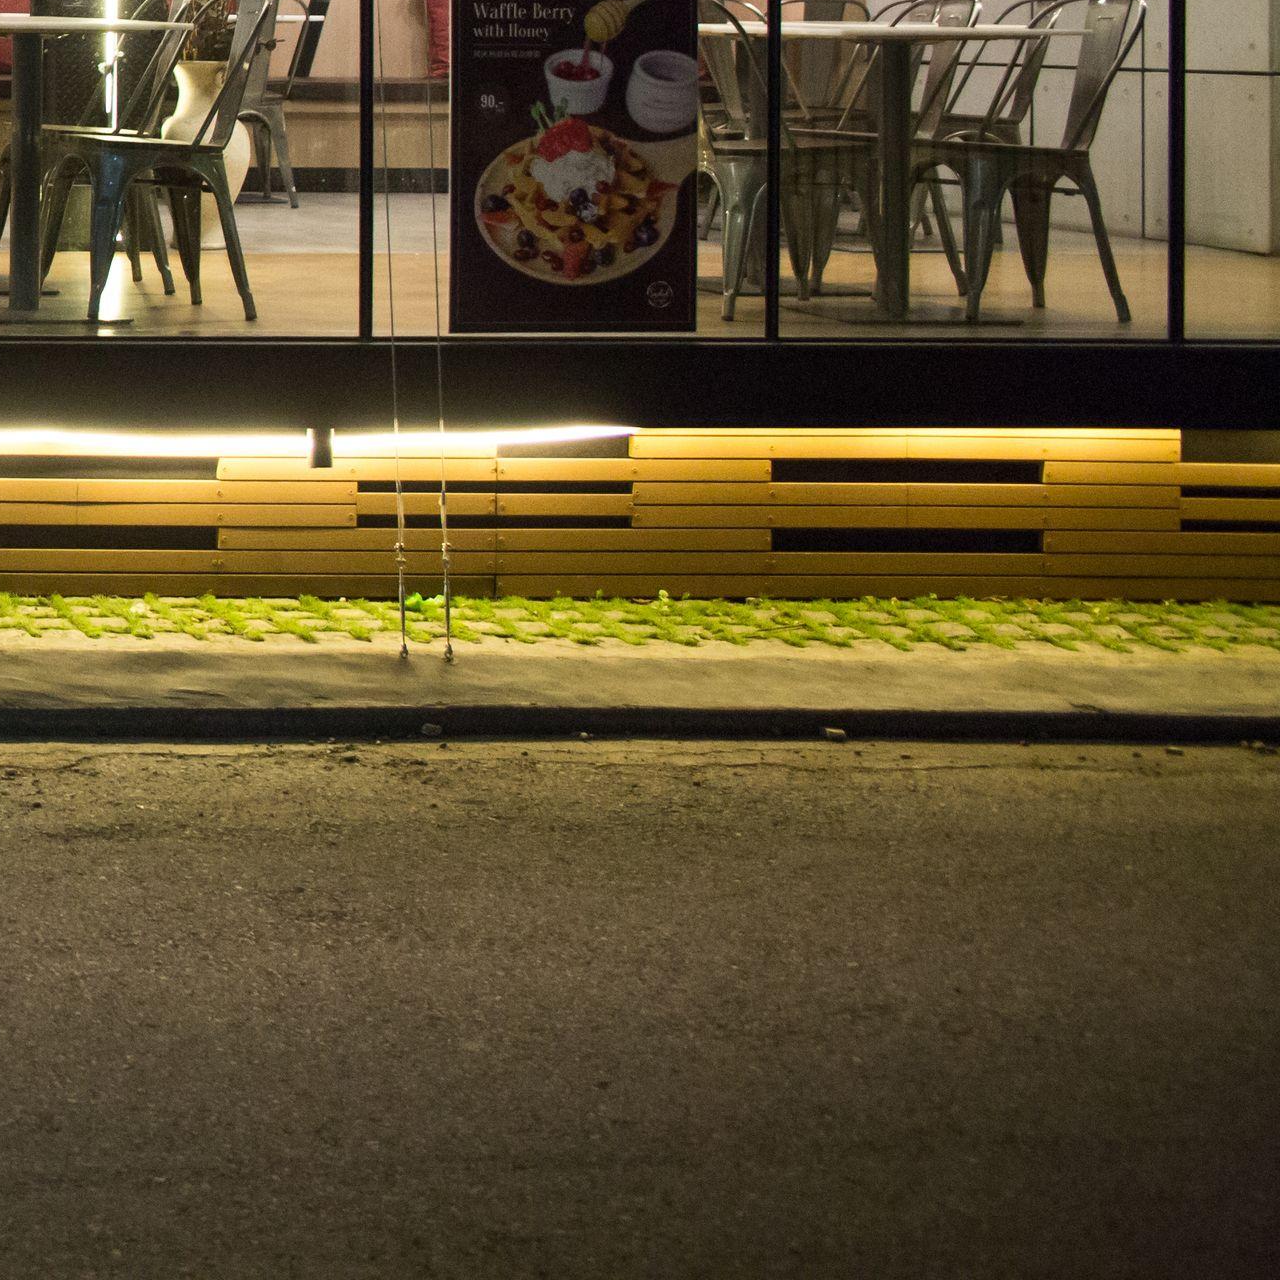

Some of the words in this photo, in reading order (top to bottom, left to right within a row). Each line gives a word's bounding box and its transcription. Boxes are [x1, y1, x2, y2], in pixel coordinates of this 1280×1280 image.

[473, 2, 527, 20] Waffle
[532, 2, 575, 25] Berry
[473, 24, 504, 38] with
[508, 23, 549, 41] Honey
